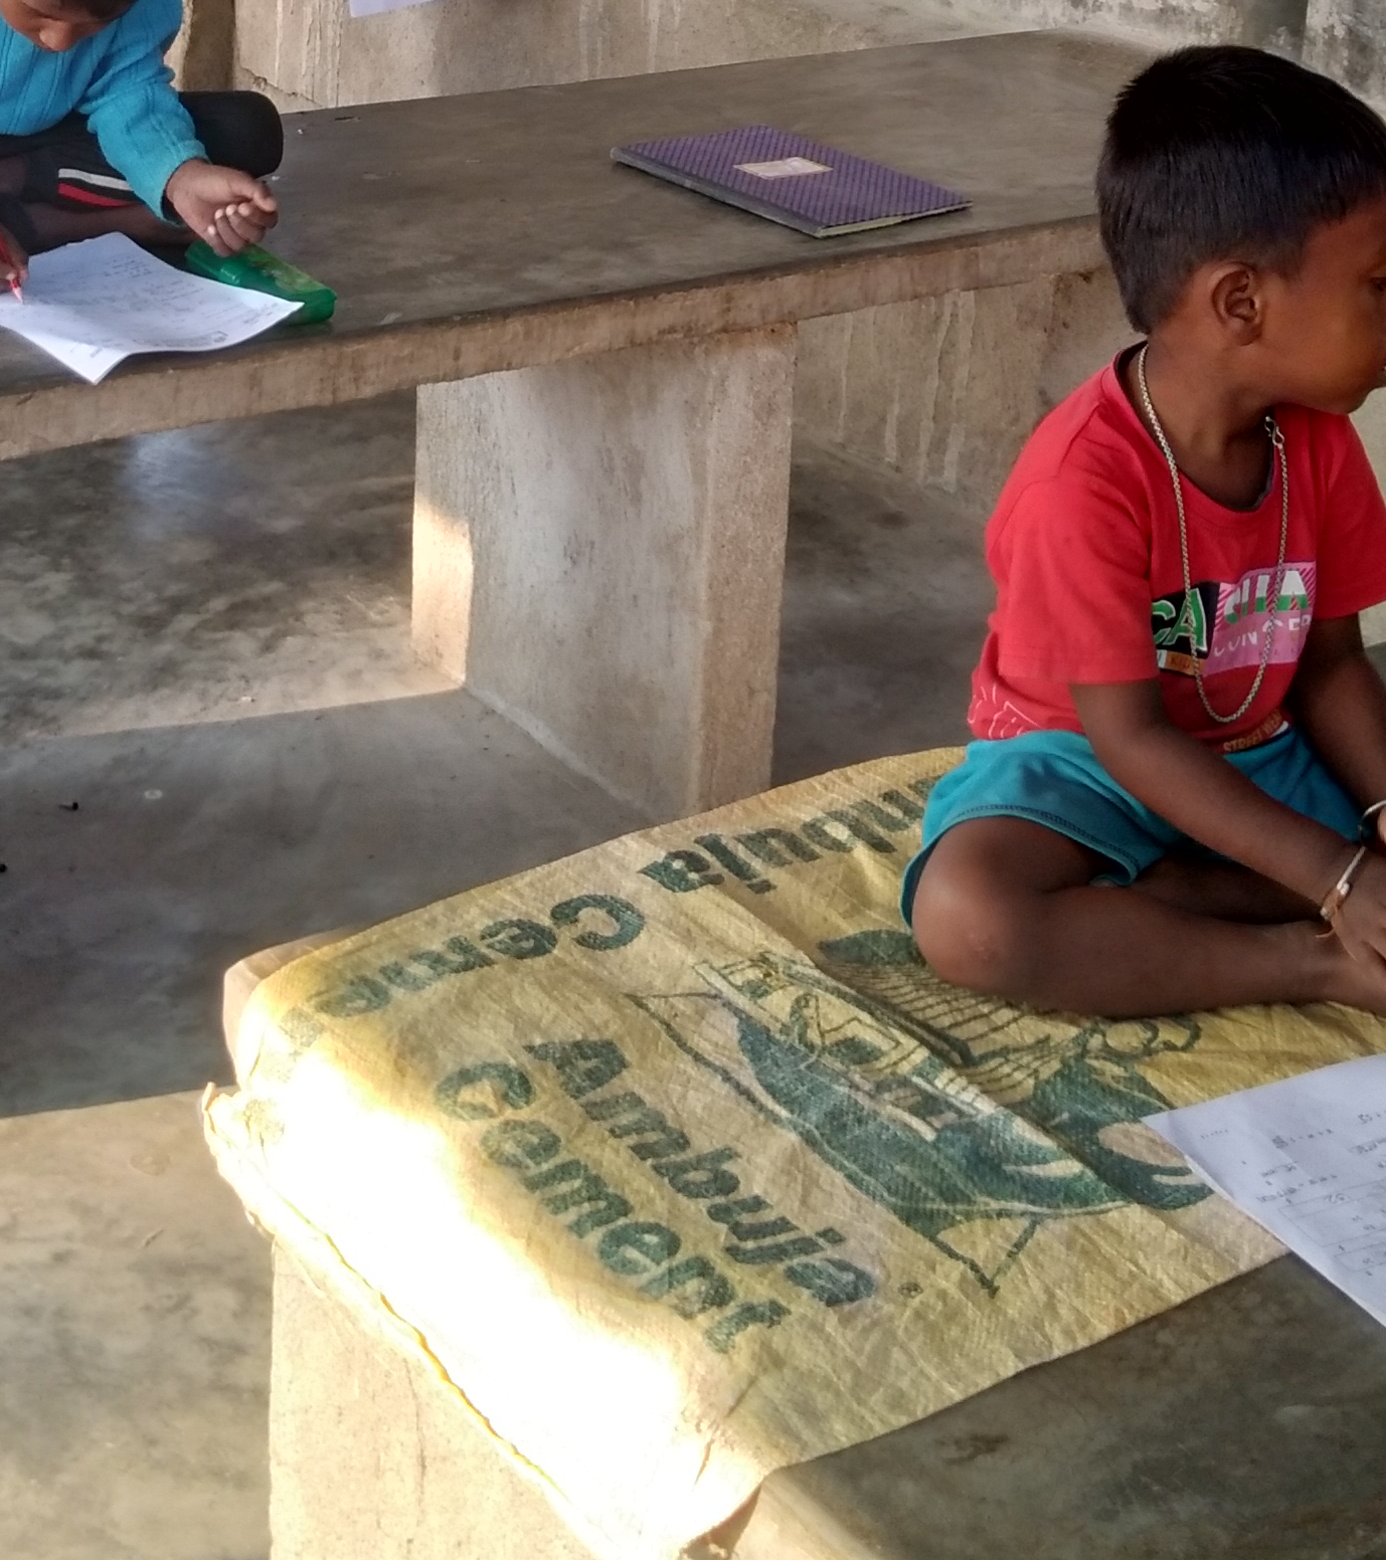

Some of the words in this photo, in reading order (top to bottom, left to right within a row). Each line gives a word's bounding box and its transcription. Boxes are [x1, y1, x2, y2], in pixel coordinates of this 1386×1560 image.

[637, 774, 943, 894] mbuja
[280, 894, 645, 1047] Ceme
[433, 1061, 792, 1354] Cement
[523, 1039, 877, 1308] Ambuja
